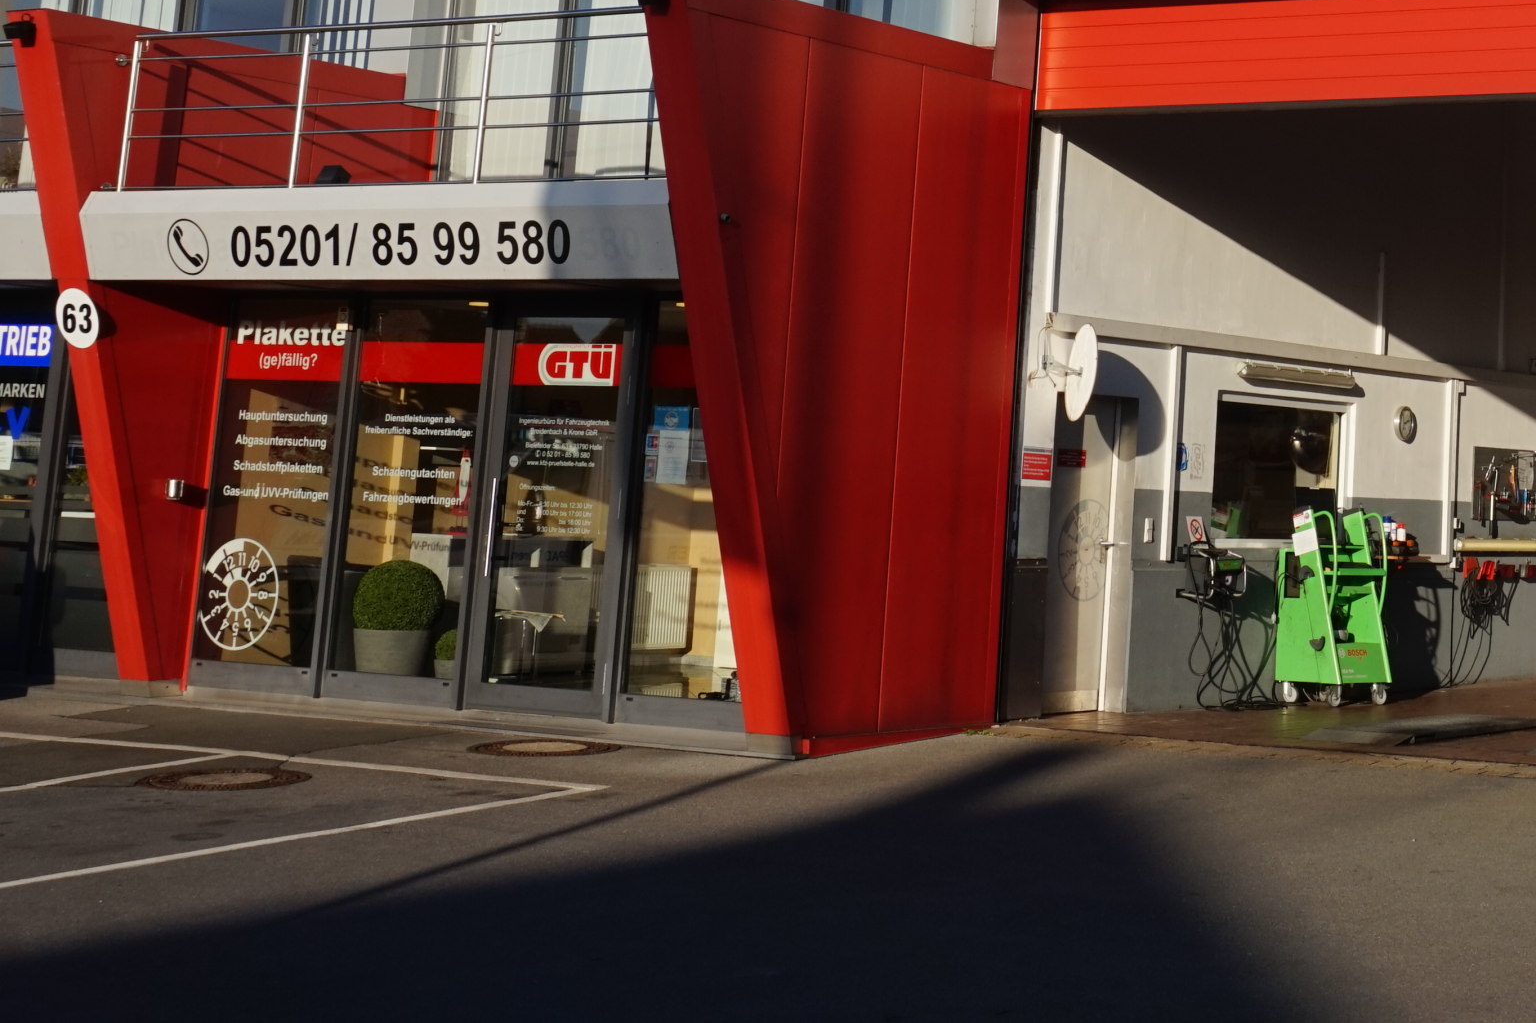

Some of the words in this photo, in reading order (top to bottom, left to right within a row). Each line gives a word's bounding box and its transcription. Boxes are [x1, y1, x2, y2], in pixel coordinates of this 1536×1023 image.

[230, 222, 359, 269] 05201/
[372, 222, 418, 266] 85
[433, 220, 481, 265] 99
[495, 218, 571, 265] 580
[62, 303, 92, 333] 63
[237, 320, 345, 346] Plakette
[259, 353, 318, 370] (ge)fällig?
[546, 344, 614, 379] GTÜ
[238, 409, 328, 425] Hauptuntersuchung
[385, 413, 443, 425] Dienstleistungen
[444, 415, 456, 424] als
[365, 426, 411, 435] freiberufliche
[412, 427, 473, 438] Sachverständige:
[235, 434, 327, 450] Abgasuntersuchung
[233, 460, 323, 475] Schadstoffplaketten
[372, 466, 455, 480] Schadengutachten
[363, 491, 462, 507] Fahrzeugbewertungen
[222, 556, 236, 572] 12
[238, 552, 247, 566] 11
[248, 555, 260, 573] 10
[212, 572, 222, 582] 1
[256, 572, 267, 582] 9
[208, 590, 220, 599] 2
[257, 590, 269, 600] 8
[210, 605, 221, 617] 3
[254, 606, 264, 619] 7
[220, 618, 230, 631] 4
[232, 622, 240, 636] 5
[244, 618, 252, 632] 6
